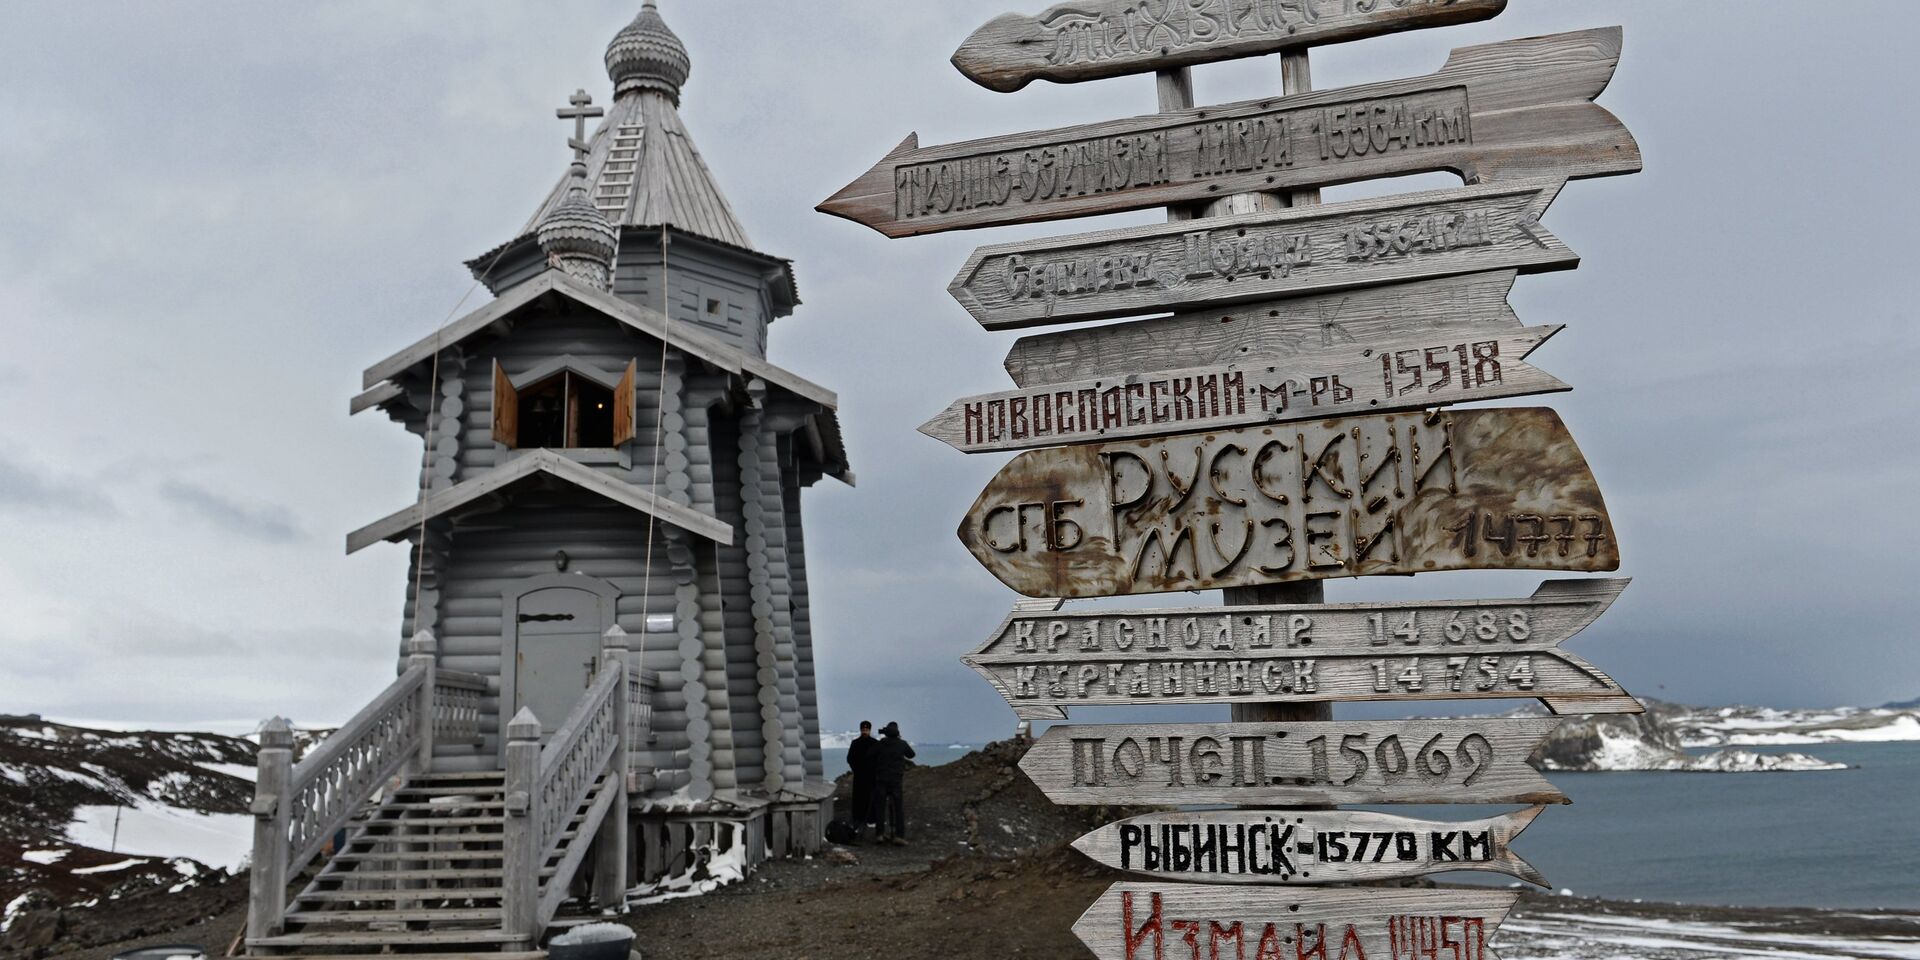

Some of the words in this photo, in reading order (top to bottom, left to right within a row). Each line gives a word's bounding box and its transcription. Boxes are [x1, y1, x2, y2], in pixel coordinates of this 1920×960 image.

[1376, 340, 1502, 398] 15518
[1443, 511, 1607, 558] 14777
[1013, 613, 1313, 651] КРАСНОДАР
[1367, 610, 1420, 646] 14
[1443, 609, 1532, 642] 688
[1370, 655, 1424, 692] 14
[1446, 655, 1534, 692] 754
[1071, 735, 1267, 788] ПОЧЕП
[1305, 731, 1494, 787] 15069
[1431, 830, 1491, 862] КМ
